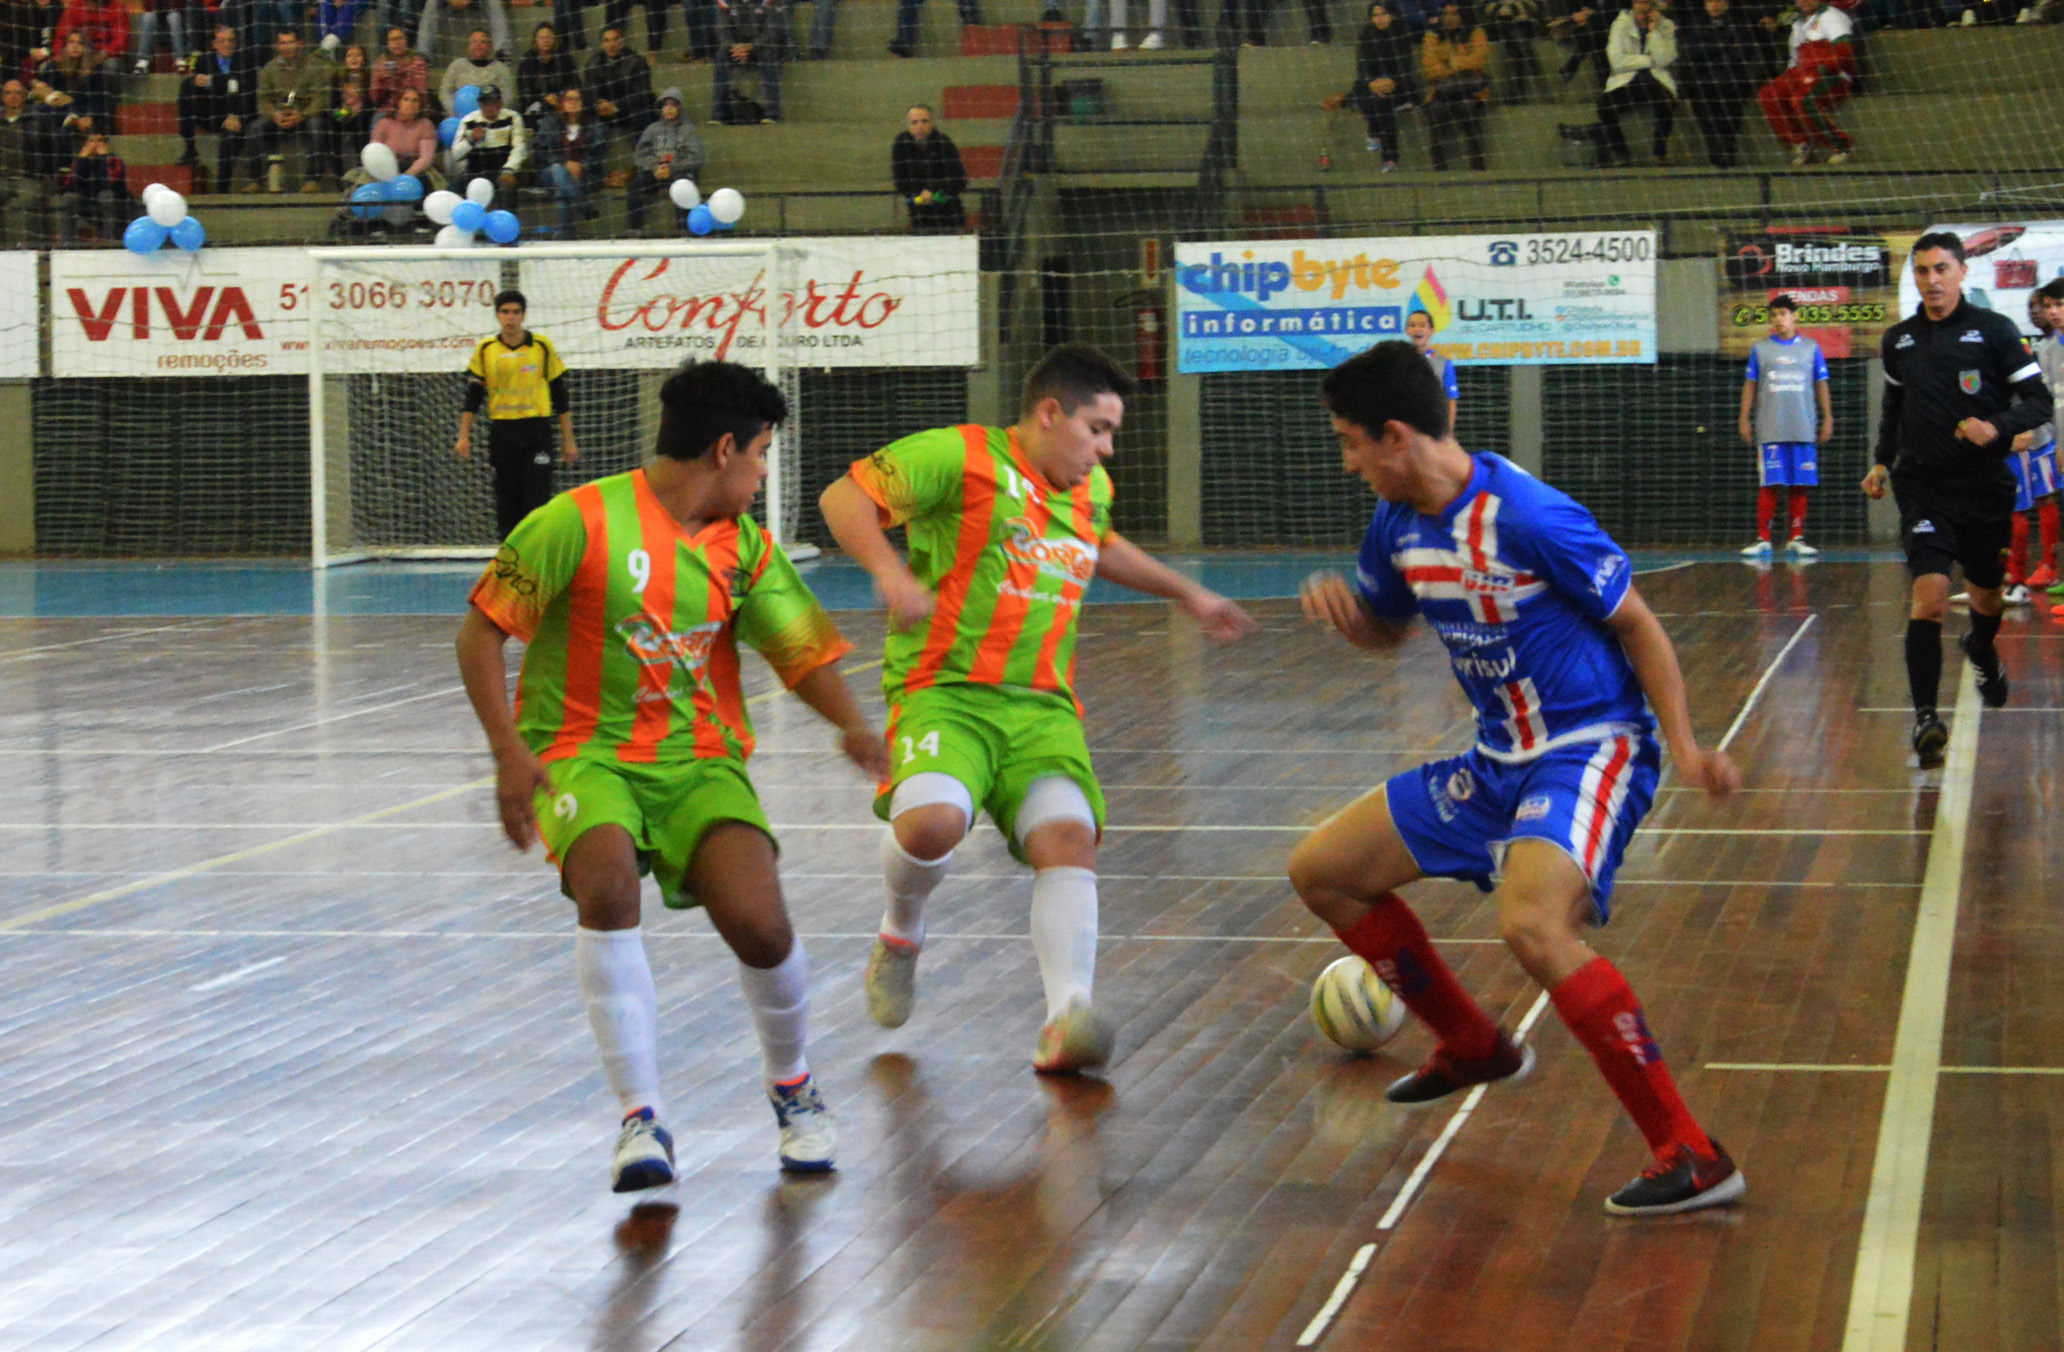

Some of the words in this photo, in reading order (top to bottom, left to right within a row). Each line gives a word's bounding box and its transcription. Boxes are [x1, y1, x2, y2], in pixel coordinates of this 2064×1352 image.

[1527, 236, 1649, 264] 3524-4500
[1775, 242, 1880, 263] Brindes
[1182, 250, 1400, 300] chipbyte
[279, 283, 309, 310] 51
[329, 282, 407, 309] 3066
[419, 280, 495, 308] 3070
[67, 286, 264, 341] VIVA
[597, 258, 903, 362] Conforto
[1189, 310, 1396, 334] informática
[1458, 298, 1533, 321] U.T.I.
[625, 336, 715, 348] ARTEFATOS
[737, 336, 758, 347] DE
[823, 335, 864, 347] LTDA
[158, 349, 268, 369] remoções
[628, 549, 651, 593] 9
[901, 731, 941, 765] 14
[554, 793, 578, 821] 9
